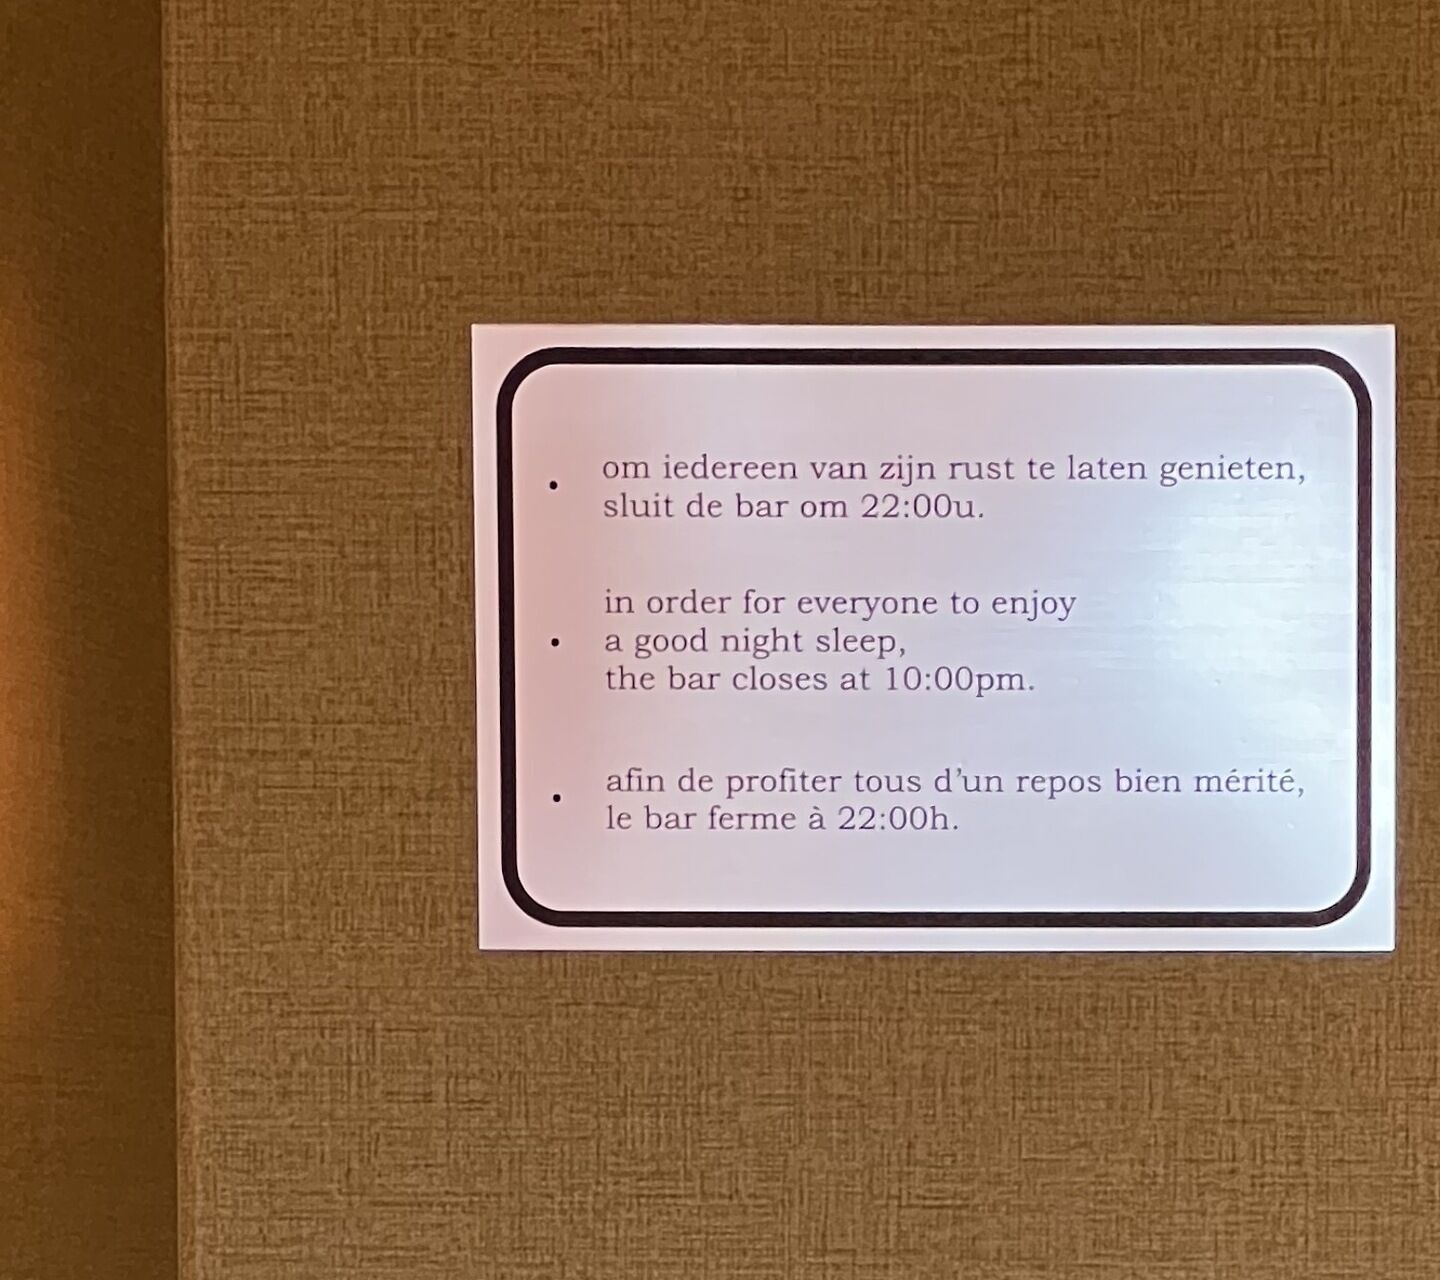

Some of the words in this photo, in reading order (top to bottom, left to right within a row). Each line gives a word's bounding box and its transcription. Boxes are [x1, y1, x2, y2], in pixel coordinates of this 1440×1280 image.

[602, 460, 652, 480] om
[661, 452, 799, 481] iedereen
[808, 461, 869, 481] van
[878, 453, 937, 489] zijn
[947, 457, 1016, 481] rust
[1026, 457, 1057, 481] te
[1067, 453, 1149, 481] laten
[1159, 453, 1306, 488] genieten,
[603, 490, 675, 519] sluit
[685, 490, 723, 519] de
[734, 491, 790, 519] bar
[799, 499, 850, 519] om
[860, 491, 984, 520] 22:00u.
[604, 587, 636, 615] in
[646, 587, 733, 615] order
[742, 587, 788, 615] for
[796, 595, 939, 623] everyone
[949, 591, 981, 615] to
[991, 588, 1078, 623] enjoy
[604, 633, 625, 653] a
[633, 625, 710, 661] good
[719, 625, 805, 661] night
[815, 625, 906, 661] sleep,
[605, 663, 656, 691] the
[666, 664, 723, 691] bar
[731, 664, 829, 692] closes
[838, 668, 871, 692] at
[885, 665, 1035, 699] 10:00pm.
[605, 766, 666, 793] afin
[677, 766, 714, 793] de
[725, 766, 843, 801] profiter
[853, 770, 922, 795] tous
[1015, 774, 1103, 801] repos
[1114, 767, 1182, 794] bien
[1192, 767, 1305, 798] mérité,
[606, 803, 633, 831] le
[642, 803, 698, 831] bar
[707, 803, 798, 831] ferme
[807, 804, 828, 831] à
[837, 804, 959, 832] 22:00h.
